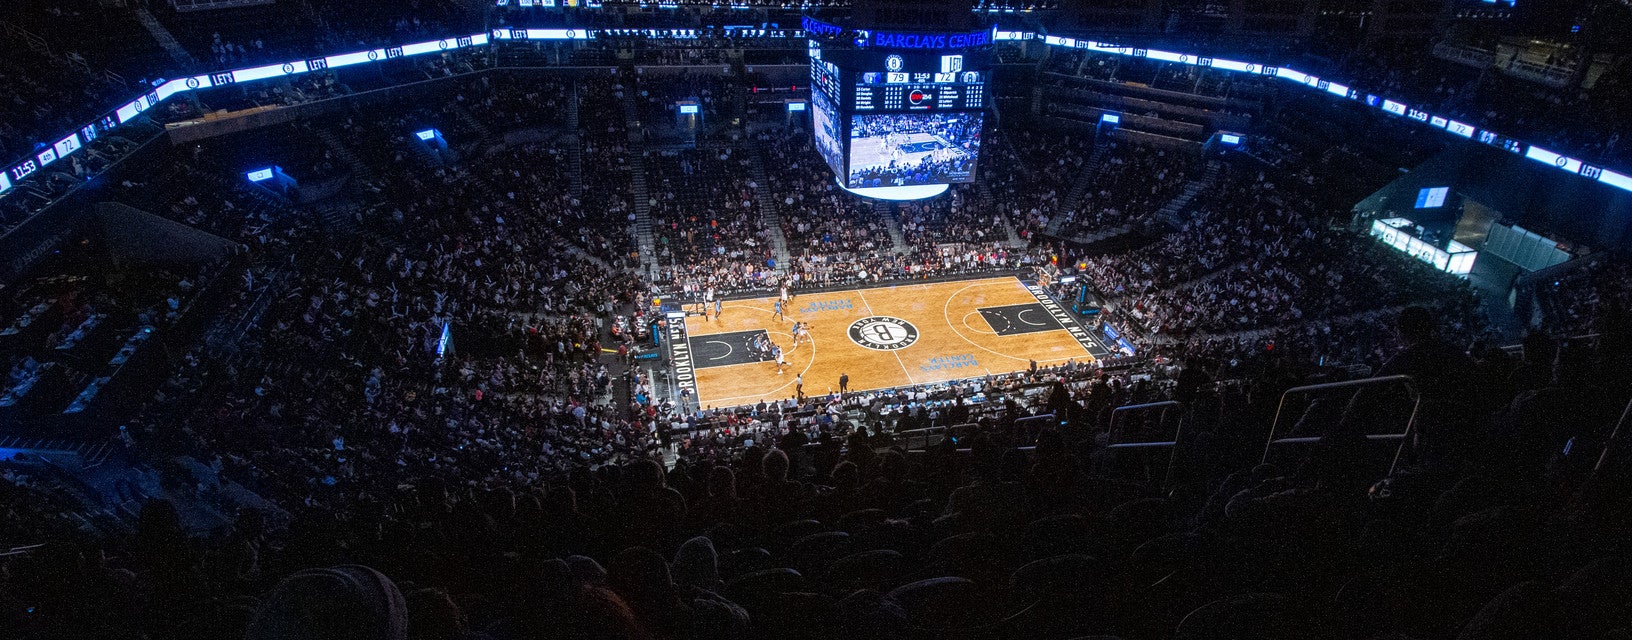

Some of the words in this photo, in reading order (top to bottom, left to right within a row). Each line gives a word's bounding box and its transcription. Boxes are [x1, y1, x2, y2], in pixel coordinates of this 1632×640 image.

[809, 20, 842, 36] CENTER
[512, 30, 527, 39] LET'S
[876, 32, 945, 49] BARCLAYS
[949, 31, 987, 48] CENTER
[458, 37, 472, 47] LET'S
[1075, 39, 1089, 49] LET'S
[387, 47, 403, 58] LET'S
[1133, 48, 1148, 58] LET'S
[308, 58, 326, 71] LET'S
[1197, 56, 1212, 67] LET'S
[1261, 65, 1278, 76] LET'S
[212, 72, 233, 86] LET'S
[893, 74, 904, 82] 79
[940, 73, 951, 82] 72
[1389, 103, 1399, 112] 79
[1408, 108, 1428, 122] 11:53
[1454, 124, 1466, 134] 72
[12, 160, 36, 180] 11:53
[42, 152, 52, 163] 4th
[62, 140, 74, 152] 72
[1580, 164, 1601, 179] LET'S
[881, 317, 905, 326] NEW
[1028, 284, 1073, 324] BROOKLYN
[1068, 326, 1097, 348] NETS
[852, 317, 876, 330] YORK
[872, 324, 894, 340] B
[858, 334, 916, 350] BROOKLYN
[928, 354, 974, 364] CENTER
[920, 360, 978, 372] BARCLAYS
